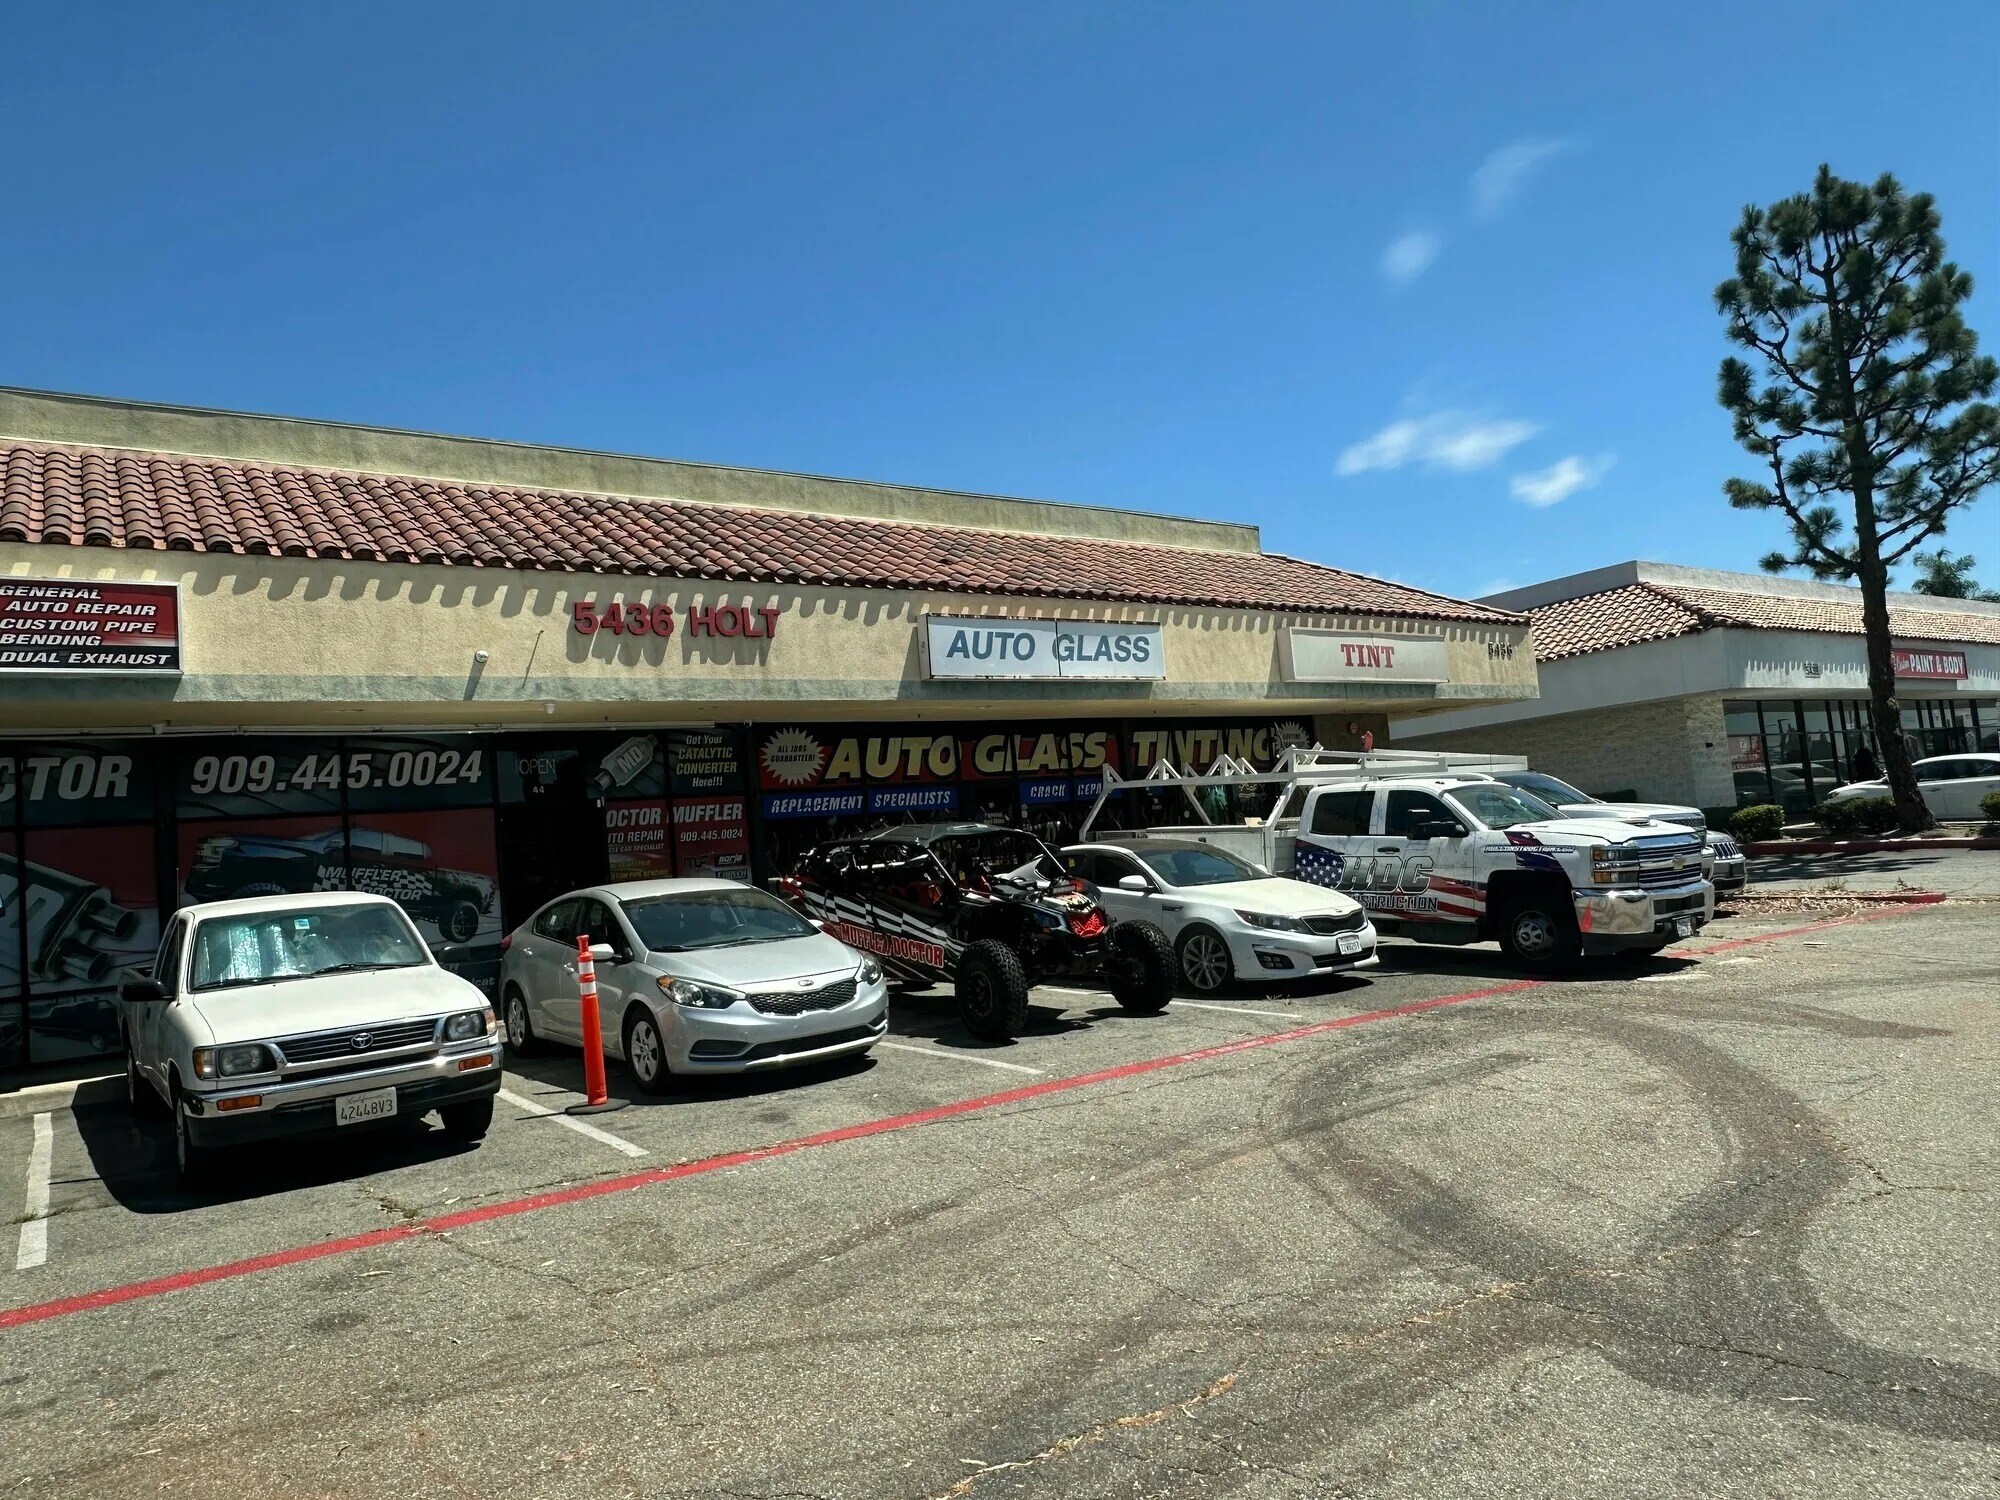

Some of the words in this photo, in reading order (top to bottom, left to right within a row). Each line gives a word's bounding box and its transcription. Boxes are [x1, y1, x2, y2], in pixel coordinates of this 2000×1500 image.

[0, 585, 102, 600] GENERAL
[5, 600, 69, 614] AUTO
[75, 603, 157, 617] REPAIR
[0, 618, 98, 632] CUSTOM
[104, 621, 156, 634] PIPE
[574, 602, 675, 638] 5436
[688, 605, 781, 639] HOLT
[0, 634, 102, 647] BENDING
[946, 630, 1036, 662] AUTO
[1051, 633, 1151, 663] GLASS
[0, 652, 61, 664] DUAL
[68, 653, 171, 665] EXHAUST
[1340, 643, 1395, 669] TINT
[1910, 654, 1934, 673] PAINT
[1936, 656, 1943, 673] &
[1943, 656, 1964, 674] BODY
[616, 744, 644, 774] MD
[678, 747, 733, 760] CATALYTIC
[824, 735, 962, 780] AUTO
[974, 731, 1108, 773] GLASS
[190, 750, 483, 795] 909.445.0024
[519, 758, 557, 775] OPEN
[676, 762, 737, 775] CONVERTER
[1030, 784, 1066, 798] CRACK
[771, 795, 864, 814] REPLACEMENT
[874, 791, 951, 808] SPECIALISTS
[666, 803, 743, 824] MUFFLER
[627, 829, 664, 843] REPAIR
[680, 828, 743, 842] 909.445.0024
[325, 866, 401, 881] MUFFLER
[1334, 855, 1435, 894] HDC
[362, 886, 422, 900] DOCTOR
[839, 922, 891, 956] MUFFLER
[890, 935, 945, 968] DOCTOR
[340, 1099, 393, 1120] 42448V3
